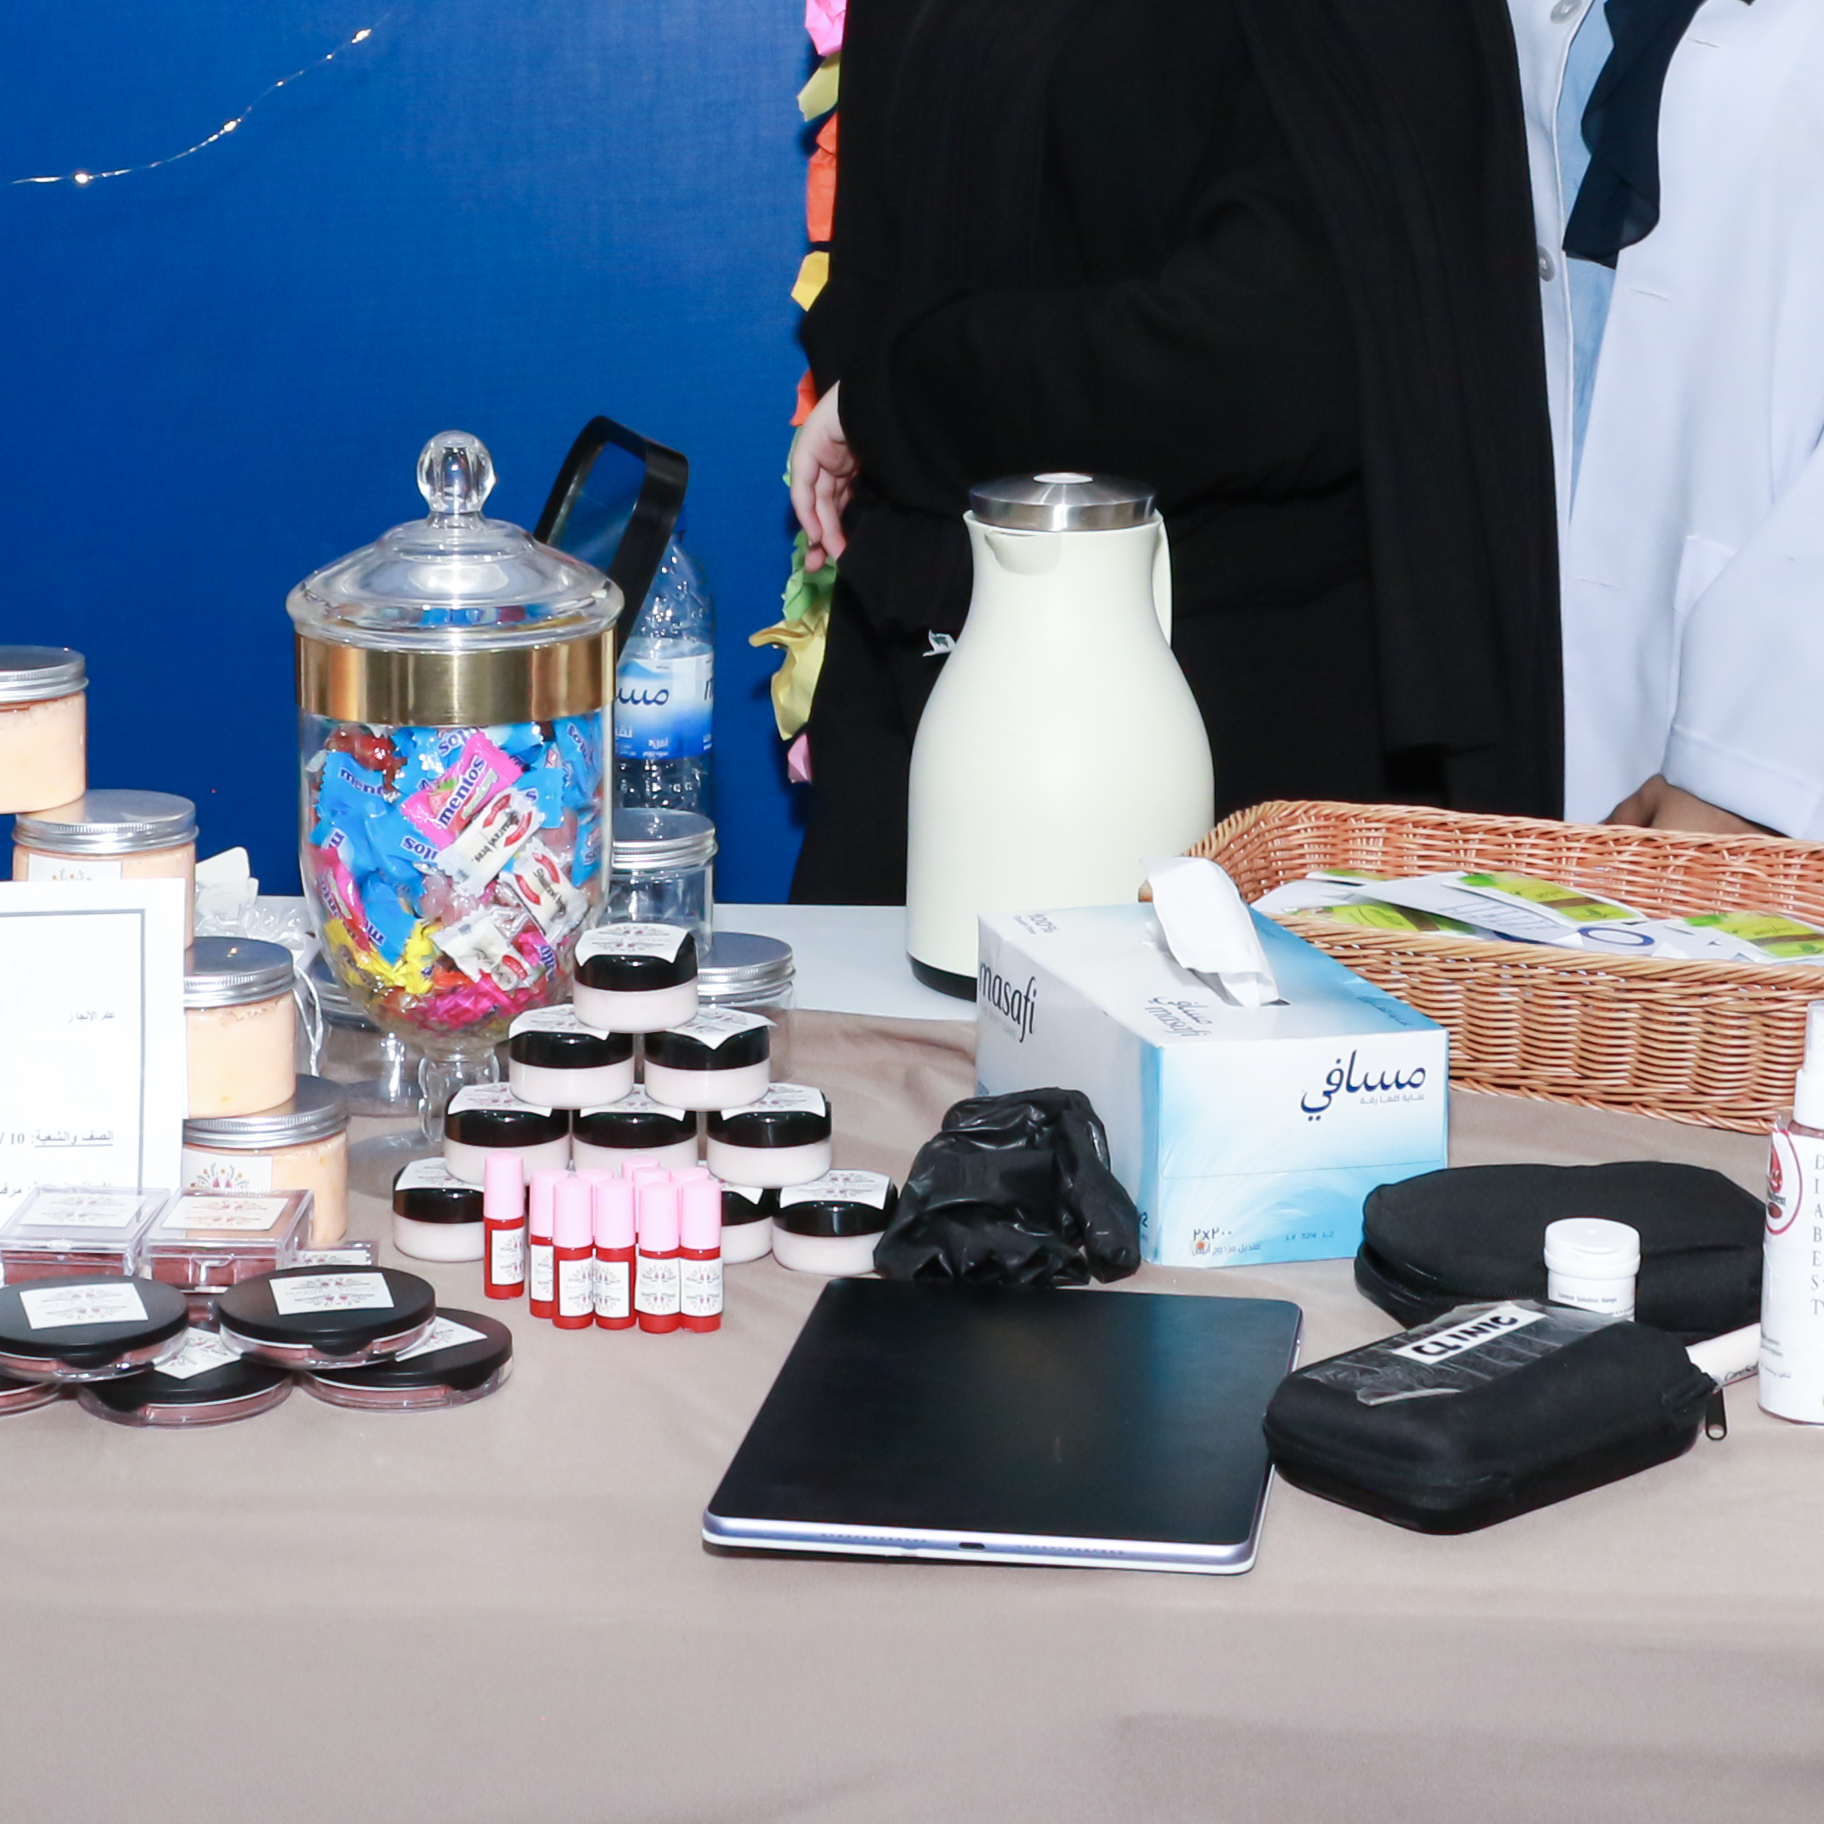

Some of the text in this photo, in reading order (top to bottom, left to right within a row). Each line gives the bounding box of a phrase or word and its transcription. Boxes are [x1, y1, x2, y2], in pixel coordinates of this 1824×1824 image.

[338, 767, 385, 796] ment
[437, 755, 488, 829] mentos
[979, 962, 1038, 1044] masafi
[1300, 1049, 1426, 1122] مسافي
[10, 1132, 26, 1145] 10
[81, 1129, 114, 1143] الصف
[1409, 1314, 1519, 1358] CLINIC
